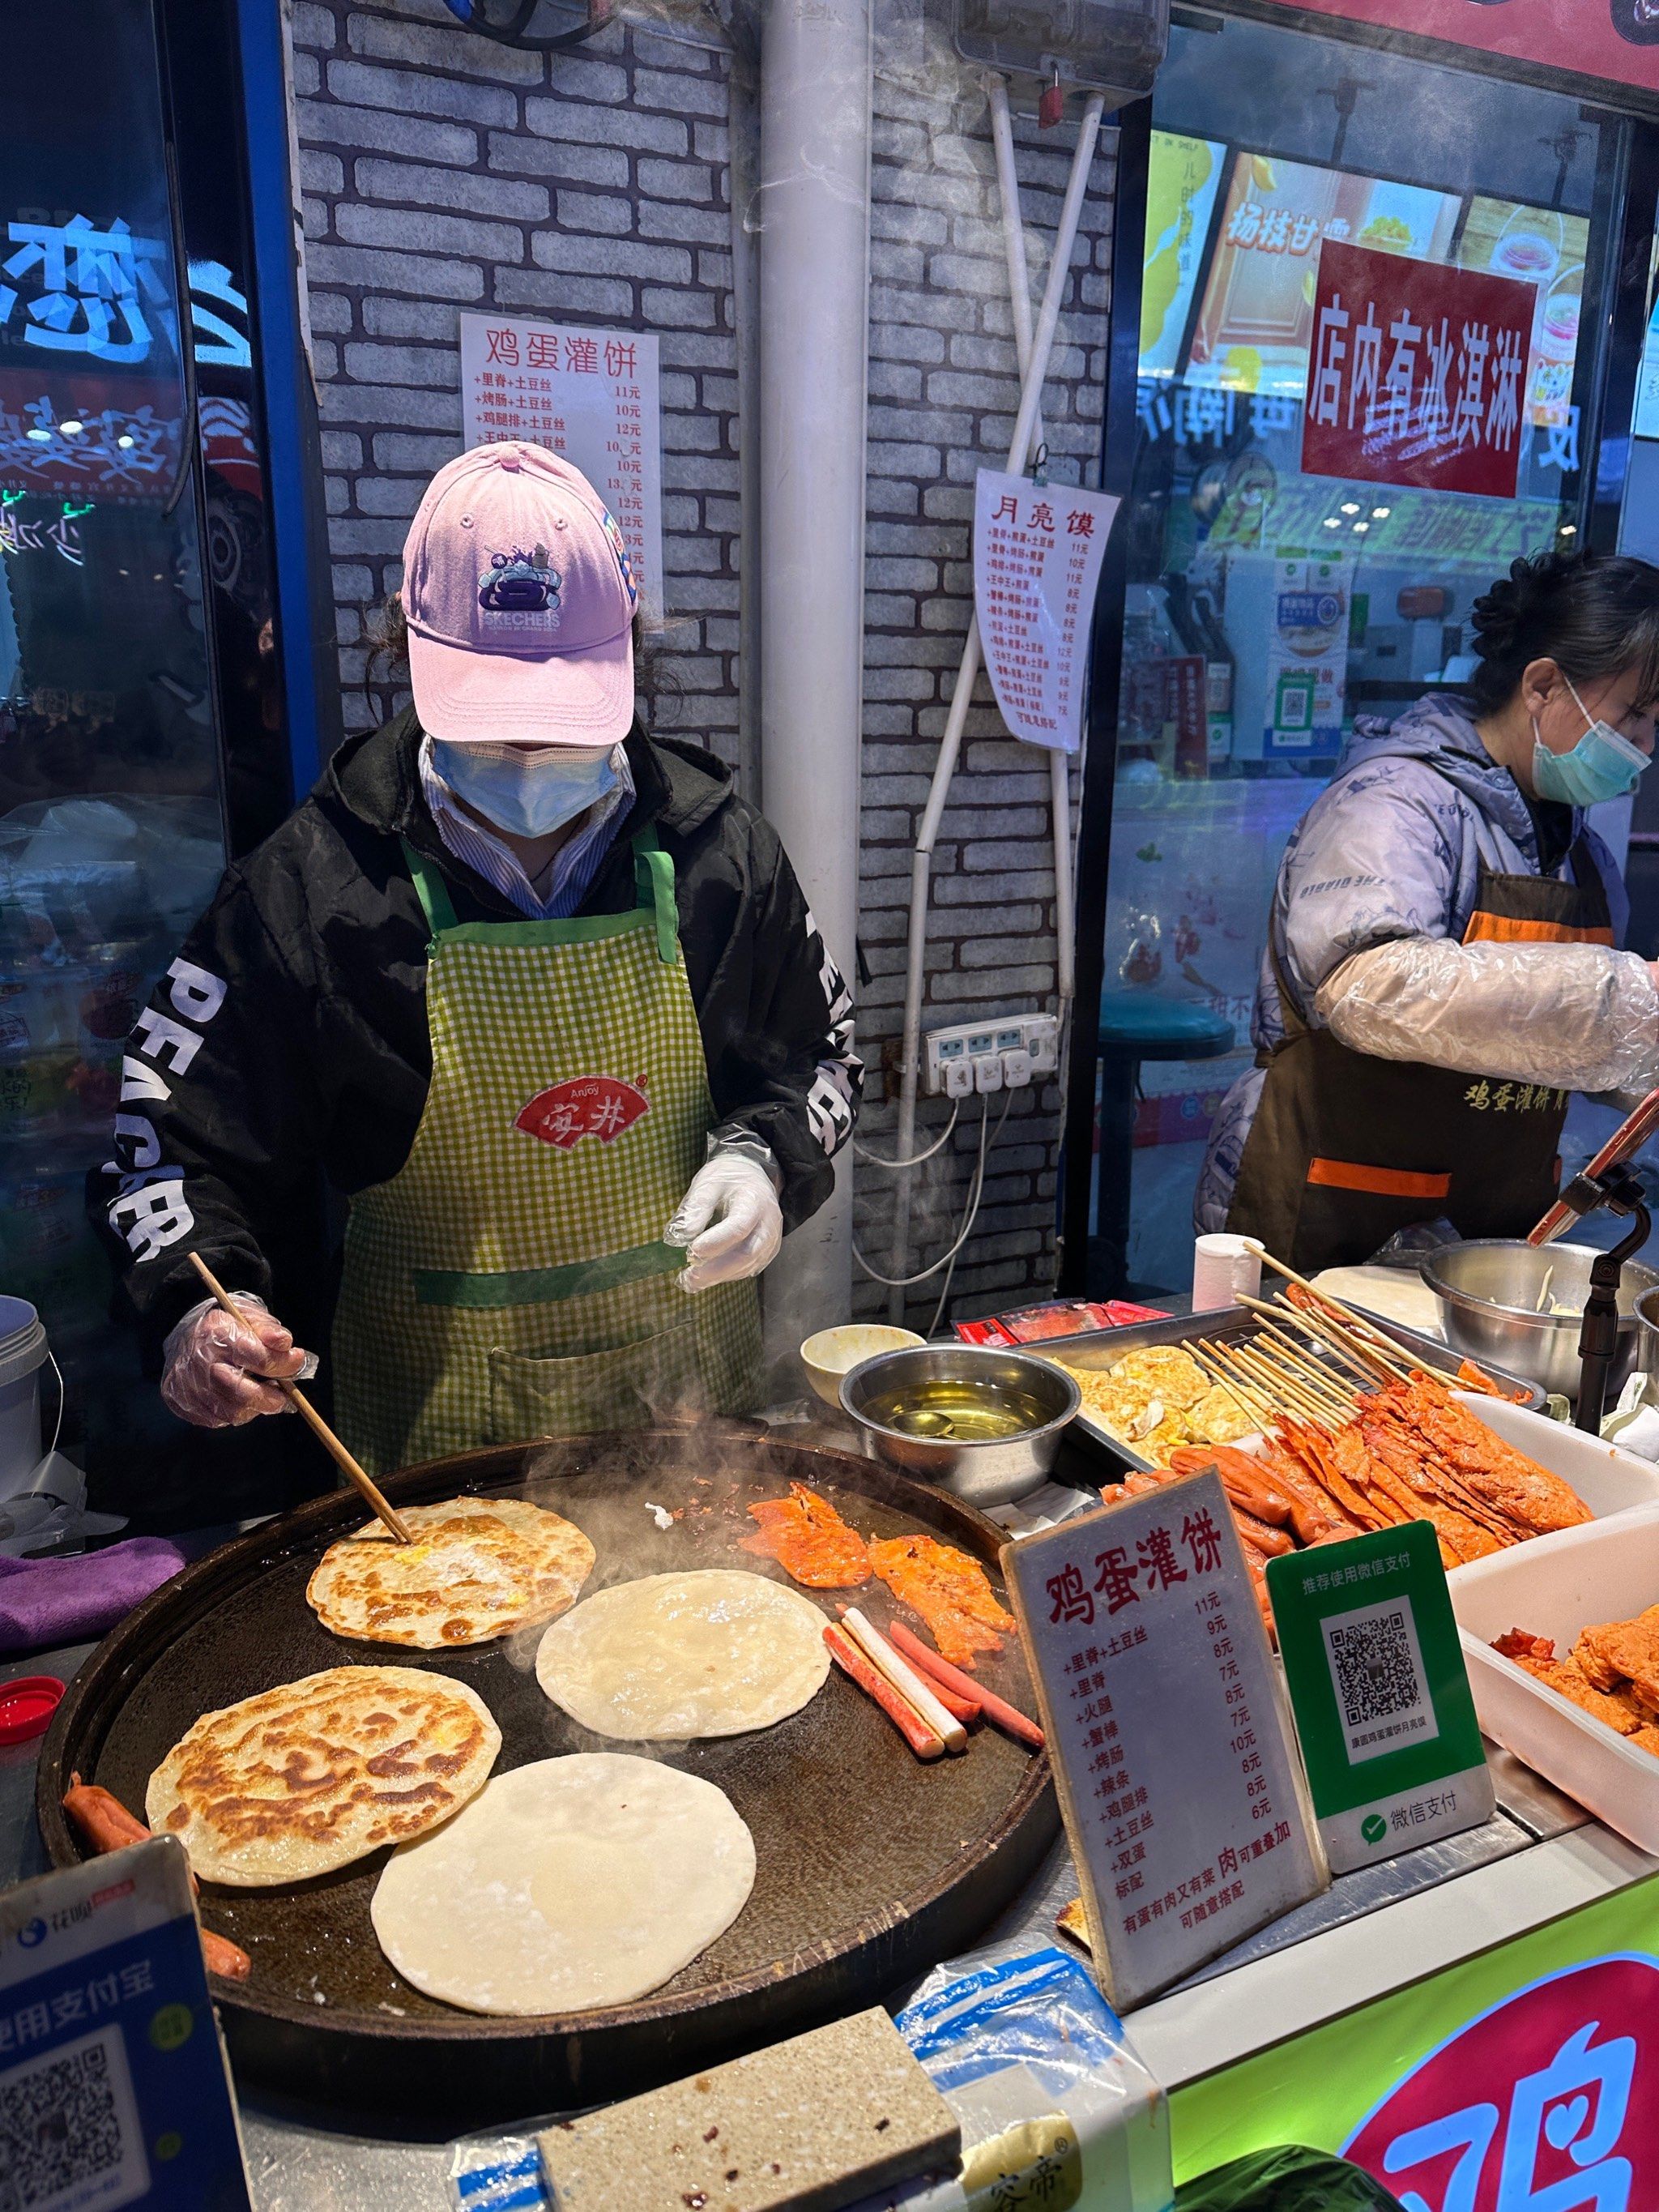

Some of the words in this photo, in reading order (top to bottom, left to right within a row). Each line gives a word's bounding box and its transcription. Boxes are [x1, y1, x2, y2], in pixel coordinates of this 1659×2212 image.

[486, 328, 638, 378] 鸡蛋灌饼
[1308, 293, 1522, 451] 店内有冰淇淋
[474, 372, 552, 391] +里脊+土豆丝
[616, 386, 640, 399] 11元
[475, 391, 552, 411] +烤肠+土豆丝
[616, 404, 641, 417] 10元
[476, 411, 565, 430] +鸡腿排+土豆丝
[616, 424, 641, 436] 12元
[617, 460, 642, 473] 10元
[618, 497, 642, 510] 12元
[618, 516, 643, 528] 12元
[991, 495, 1095, 539] 月亮馍
[1069, 558, 1085, 570] 10元
[1072, 543, 1089, 554] 11元
[1067, 573, 1082, 584] 11元
[484, 612, 561, 628] SKECHERS
[570, 1083, 599, 1099] Anjoy
[542, 1095, 625, 1142] 安井
[1046, 1507, 1222, 1625] 鸡蛋灌饼
[1302, 1551, 1410, 1595] 推荐使用微信支付
[1064, 1625, 1148, 1675] +里脊+土豆丝
[1194, 1591, 1221, 1615] 11元
[1069, 1670, 1105, 1699] +里脊
[1207, 1614, 1227, 1635] 9元
[1076, 1695, 1113, 1725] +火腿
[1213, 1638, 1233, 1658] 8元
[1081, 1719, 1119, 1749] +蟹棒
[1219, 1660, 1239, 1681] 7元
[1087, 1744, 1124, 1774] +烤肠
[1225, 1683, 1245, 1704] 8元
[1094, 1770, 1130, 1800] +辣条
[1230, 1706, 1251, 1727] 7元
[1099, 1785, 1149, 1824] +鸡腿排
[1230, 1729, 1256, 1753] 10元
[1104, 1810, 1154, 1848] +土豆丝
[1242, 1752, 1262, 1773] 8元
[1111, 1841, 1146, 1873] +双蛋
[1247, 1775, 1266, 1796] 8元
[1390, 1790, 1456, 1831] 微信支付
[1115, 1871, 1145, 1901] 标配
[1252, 1798, 1271, 1819] 6元
[1123, 1867, 1216, 1935] 有蛋有肉又有菜
[1179, 1880, 1244, 1929] 可随意搭配
